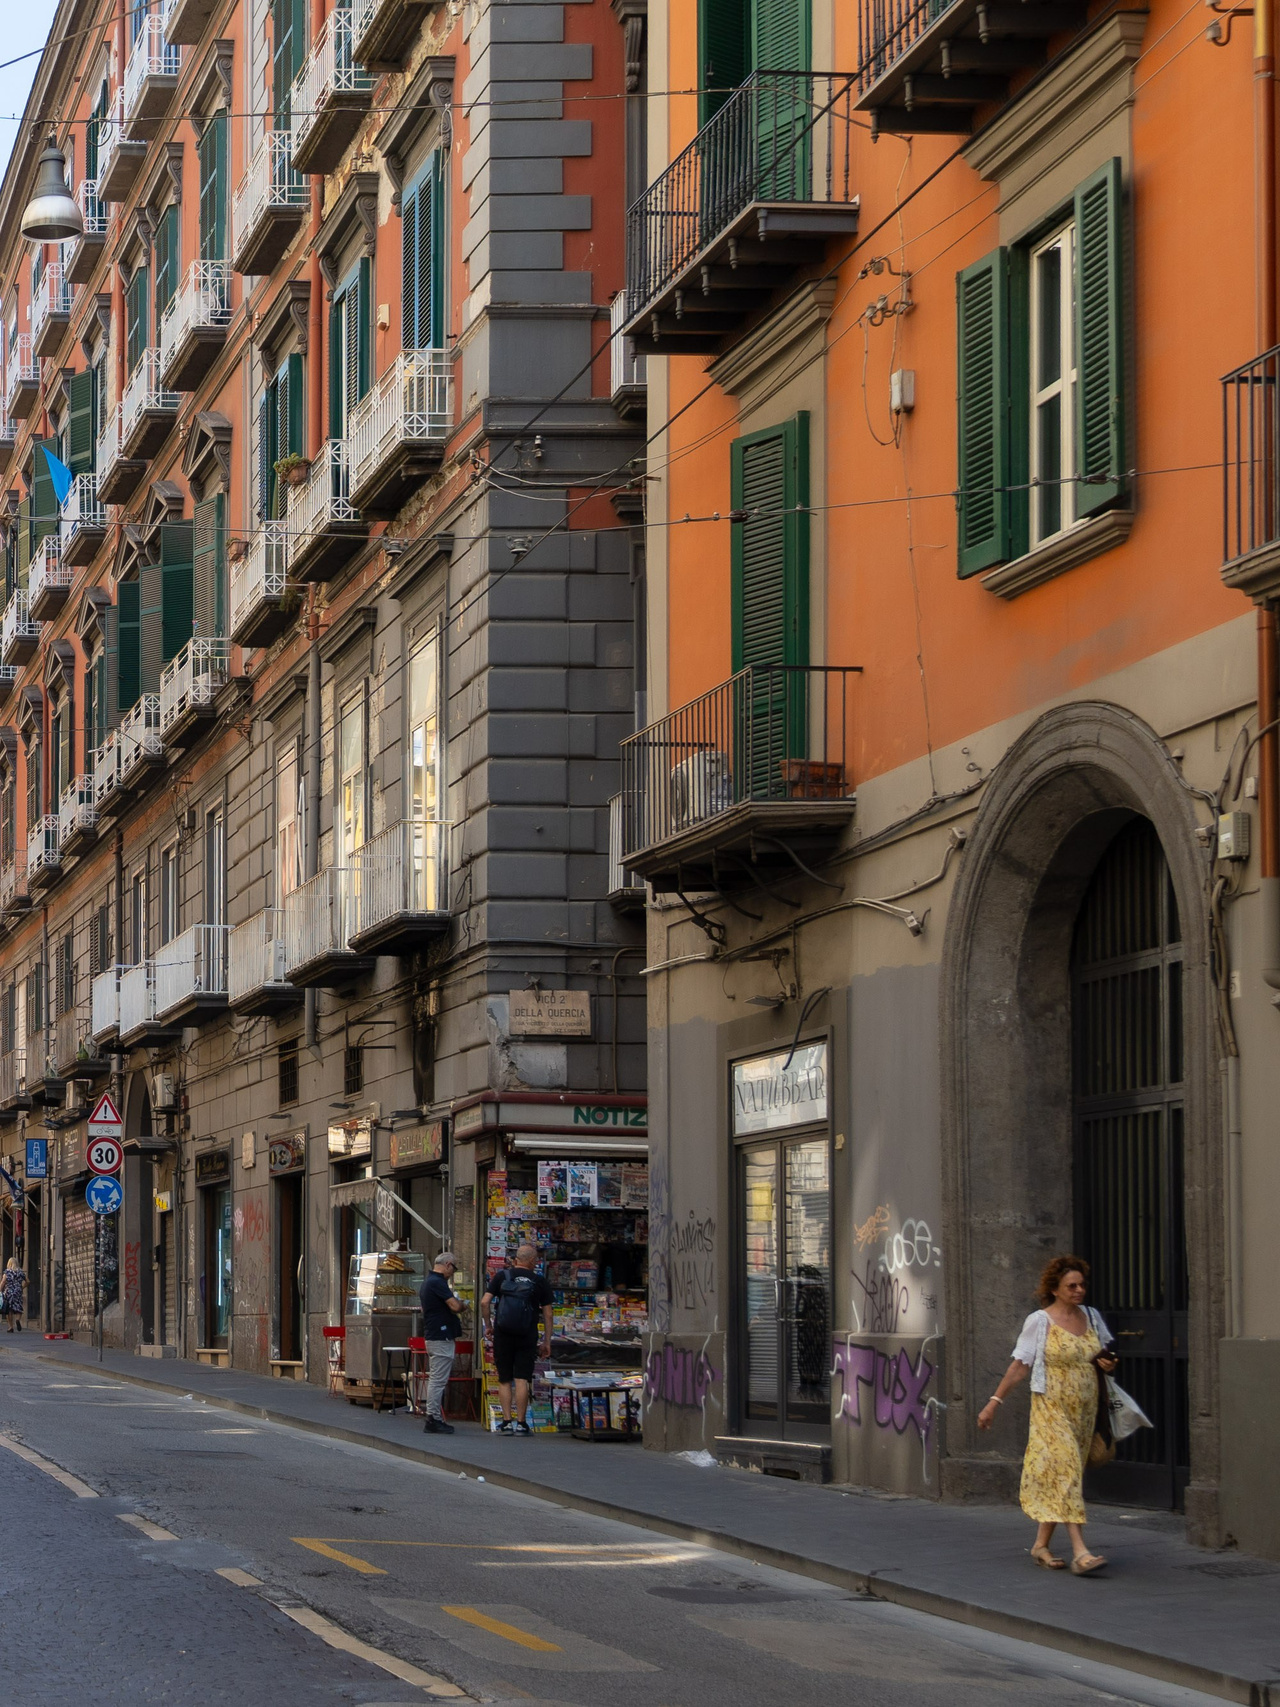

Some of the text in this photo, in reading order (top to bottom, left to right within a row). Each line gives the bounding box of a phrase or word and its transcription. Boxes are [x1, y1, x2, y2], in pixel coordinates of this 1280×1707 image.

[515, 1008, 586, 1019] DELLA QUERCIA
[94, 1148, 115, 1164] 30
